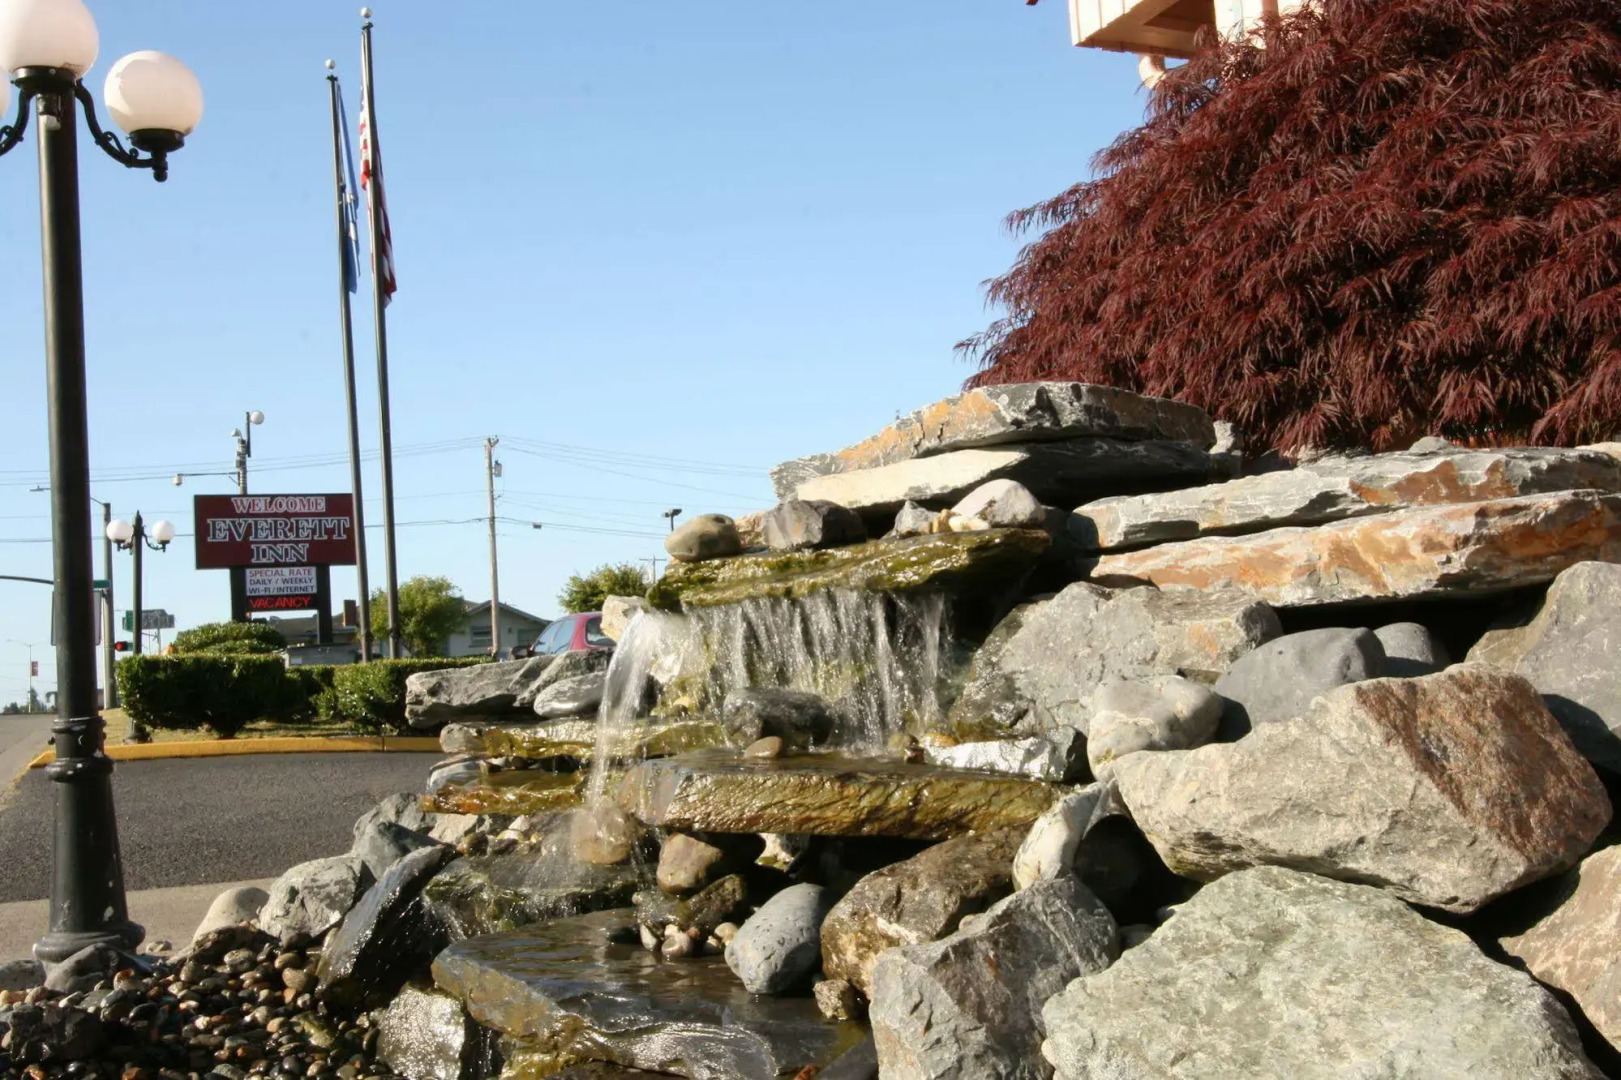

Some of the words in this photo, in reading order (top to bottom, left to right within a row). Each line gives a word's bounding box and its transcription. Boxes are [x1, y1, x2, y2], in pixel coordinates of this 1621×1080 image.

[231, 497, 326, 513] WELCOME
[207, 517, 350, 542] EVERETT
[251, 543, 309, 563] INN
[249, 569, 285, 578] SPECIAL
[289, 568, 313, 576] RATE
[249, 578, 273, 586] DAILY
[282, 576, 314, 585] WEEKLY
[248, 597, 312, 609] VACANCY
